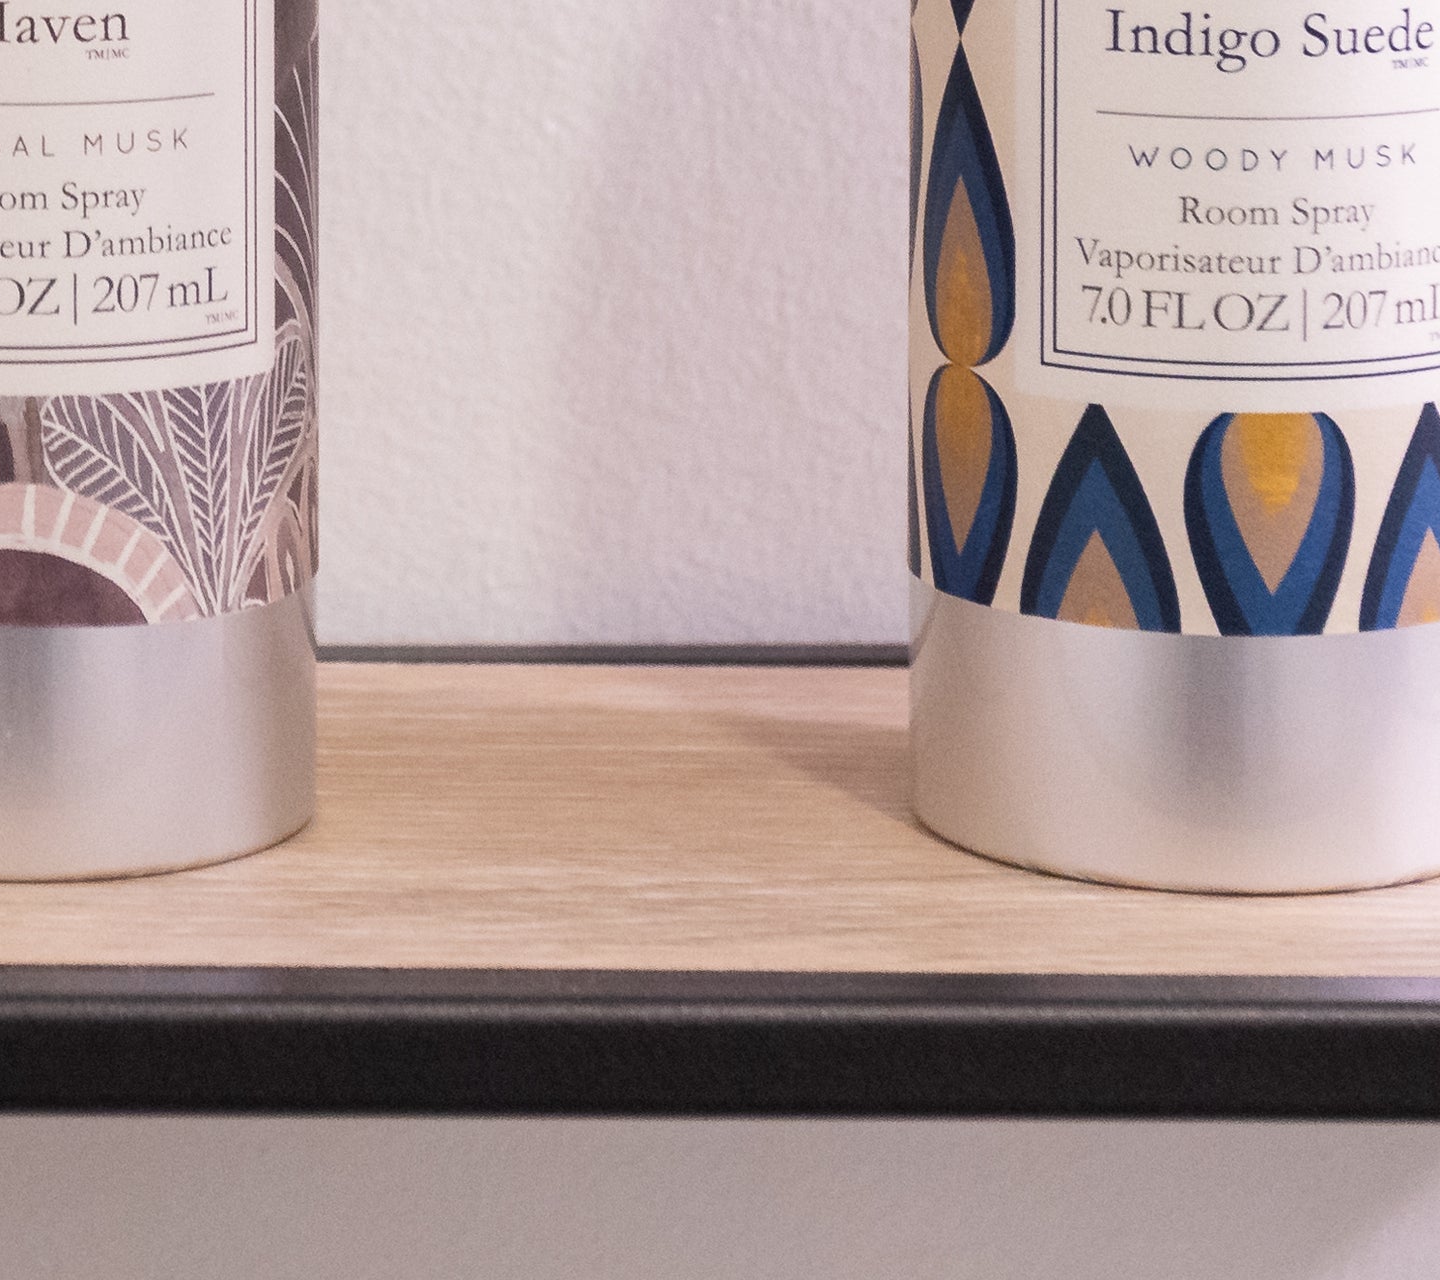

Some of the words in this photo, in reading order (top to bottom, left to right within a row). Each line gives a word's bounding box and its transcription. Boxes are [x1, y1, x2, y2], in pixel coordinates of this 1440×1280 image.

[1105, 8, 1281, 74] Indigo
[1302, 7, 1433, 57] Suede
[83, 127, 188, 156] MUSK
[1128, 144, 1287, 173] WOODY
[1313, 144, 1416, 171] MUSK
[61, 181, 145, 219] Spray
[1178, 195, 1279, 226] Room
[1291, 197, 1375, 236] Spray
[63, 224, 232, 259] D'ambiance
[1073, 235, 1281, 279] Vaporisateur
[92, 273, 160, 313] 207
[168, 266, 228, 308] mL
[1081, 284, 1132, 326] 7.0
[1142, 289, 1205, 330] FL
[1212, 293, 1289, 332] OZ
[1321, 289, 1388, 331] 207
